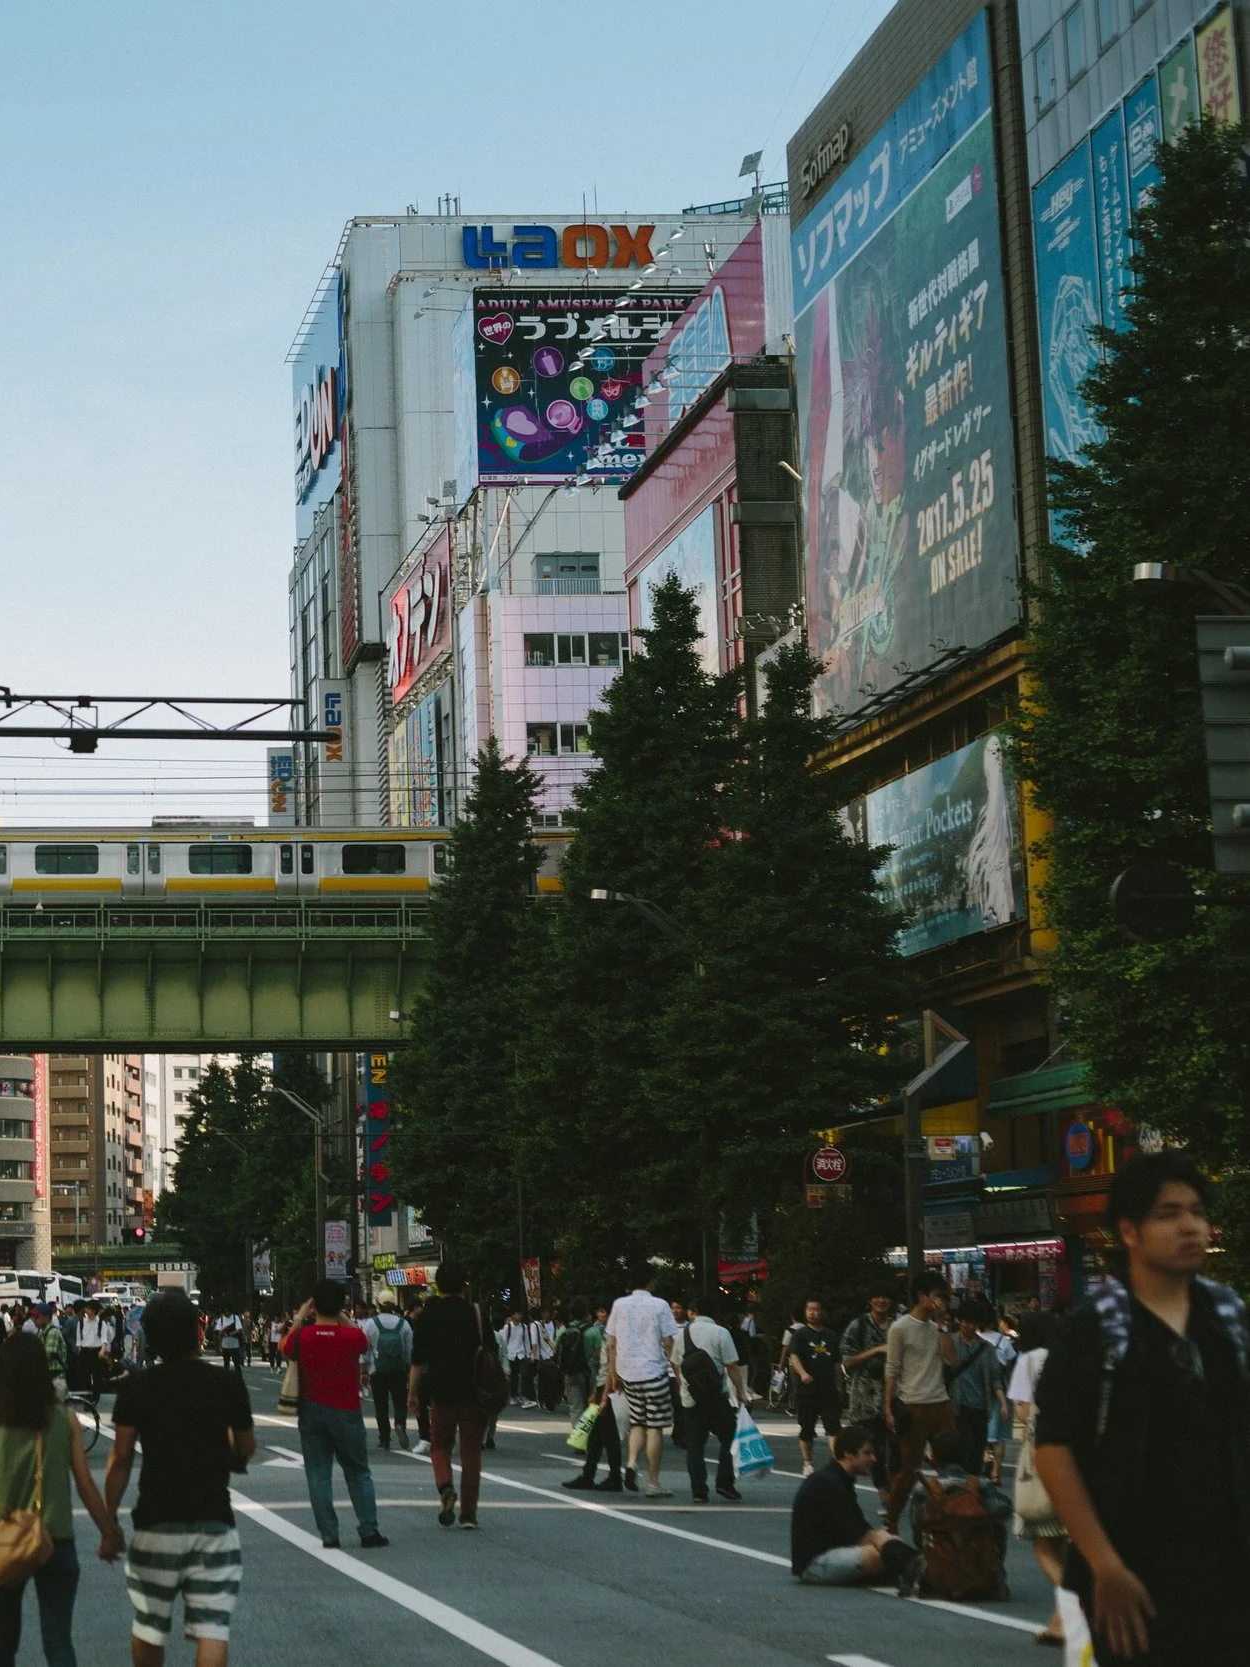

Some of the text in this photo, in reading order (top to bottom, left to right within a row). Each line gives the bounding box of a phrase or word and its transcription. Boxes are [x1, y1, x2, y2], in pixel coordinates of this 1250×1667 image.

[801, 124, 848, 199] Sofmap
[798, 141, 891, 288] ソフマップ
[477, 298, 685, 310] ADULT AMUSEMET PARK
[482, 322, 512, 336] 世界の
[905, 279, 989, 391] ギルティギア
[926, 797, 973, 839] Pockets
